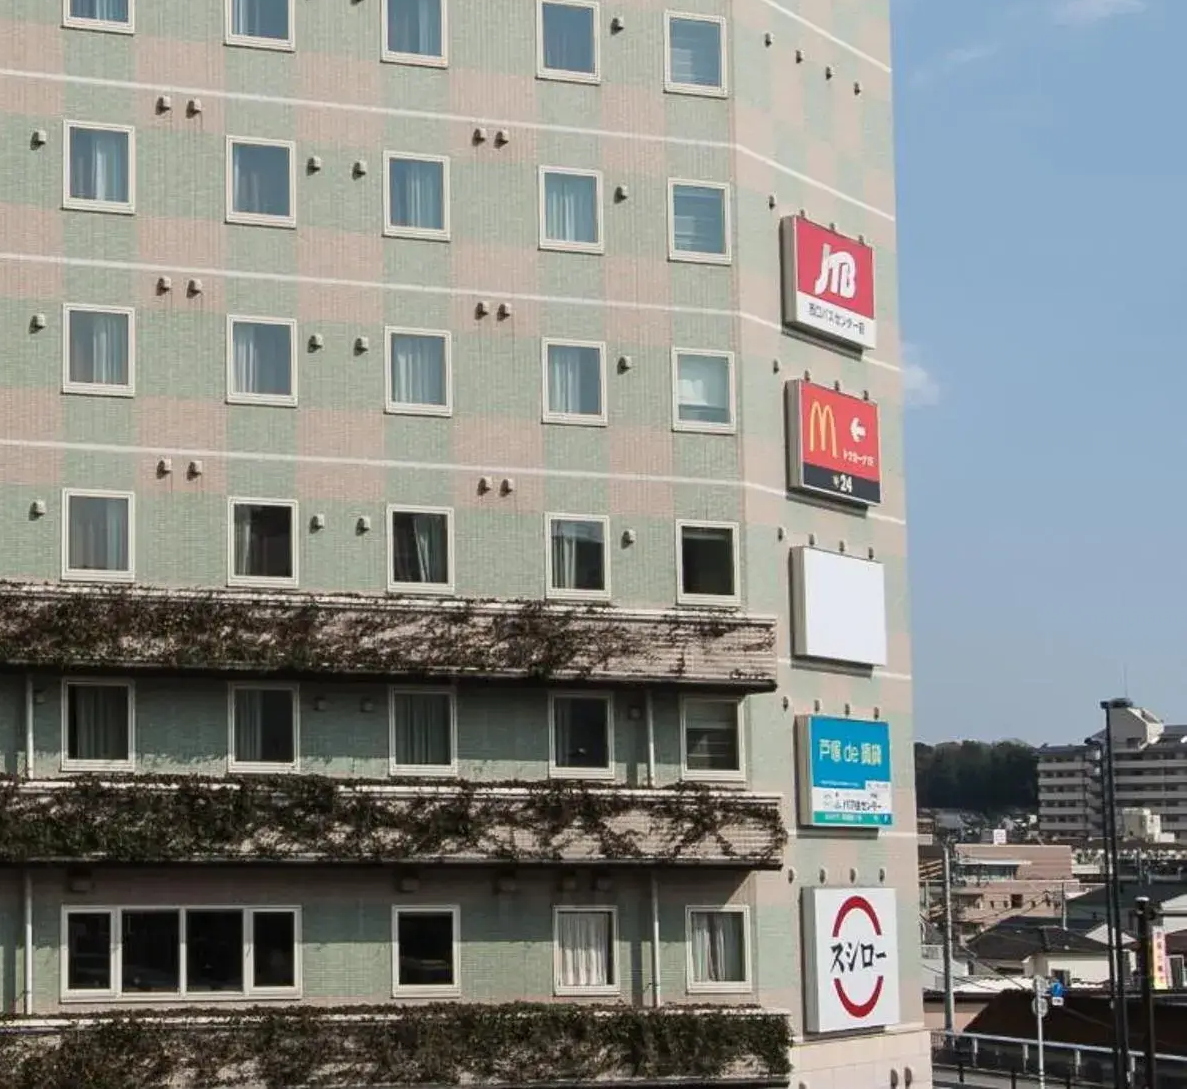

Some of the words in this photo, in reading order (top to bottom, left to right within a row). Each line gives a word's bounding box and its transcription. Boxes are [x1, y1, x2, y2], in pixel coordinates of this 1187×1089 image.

[815, 243, 855, 299] JTB
[830, 940, 887, 973] スシロー
